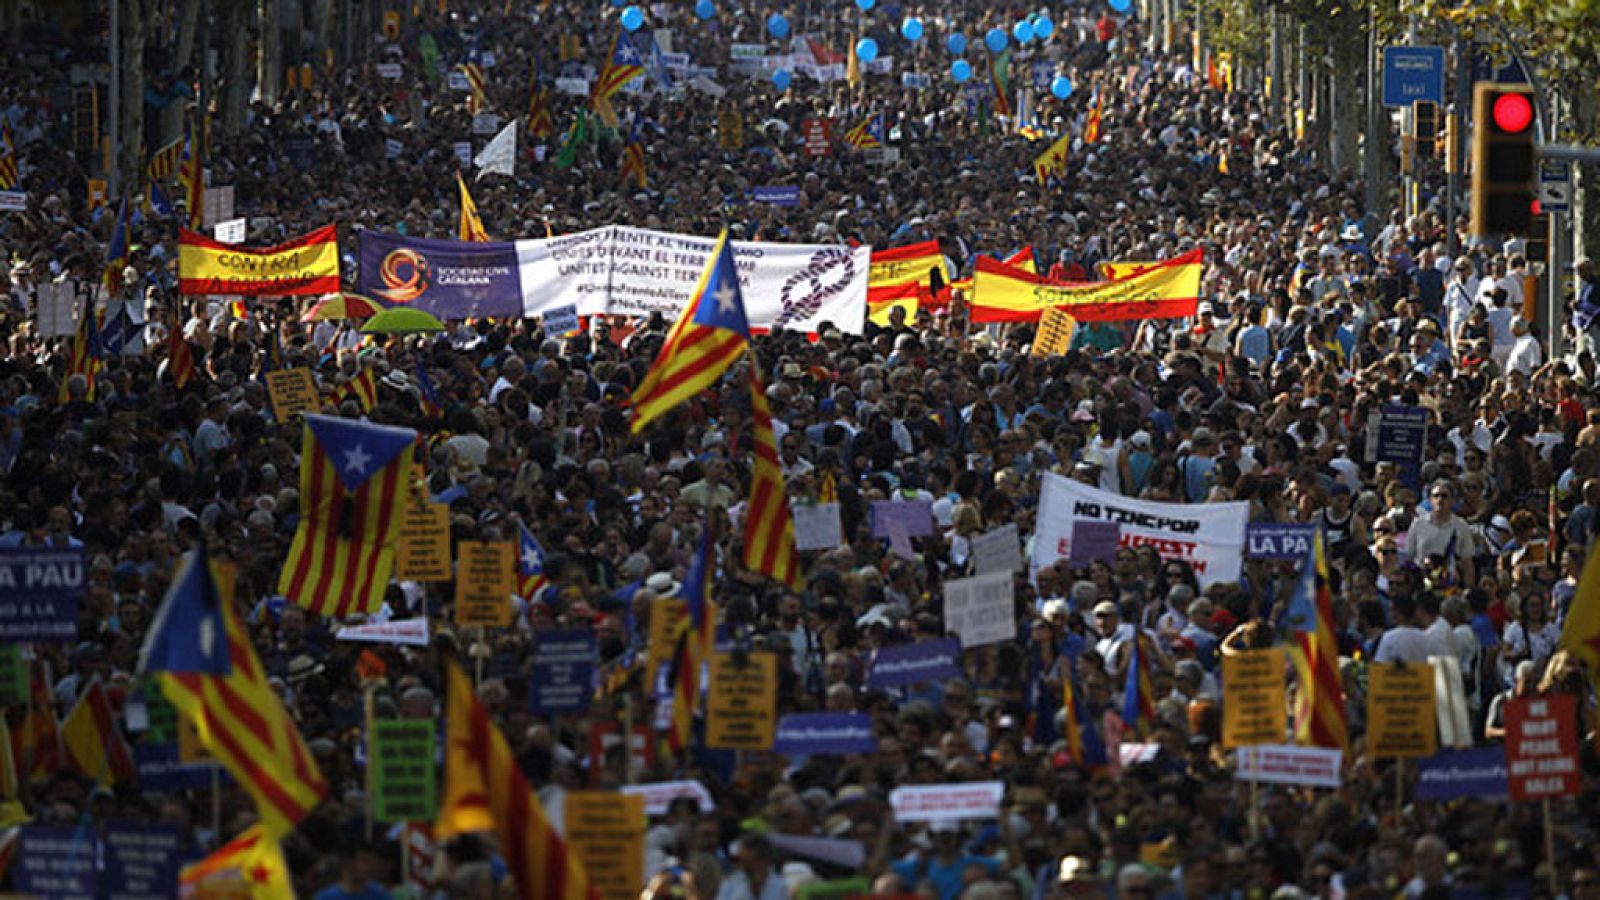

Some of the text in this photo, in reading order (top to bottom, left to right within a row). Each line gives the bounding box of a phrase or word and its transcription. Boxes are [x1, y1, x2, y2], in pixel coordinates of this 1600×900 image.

[217, 253, 299, 271] CONTRA
[1073, 502, 1101, 517] NO
[1249, 536, 1276, 554] LA
[25, 564, 82, 589] PAU
